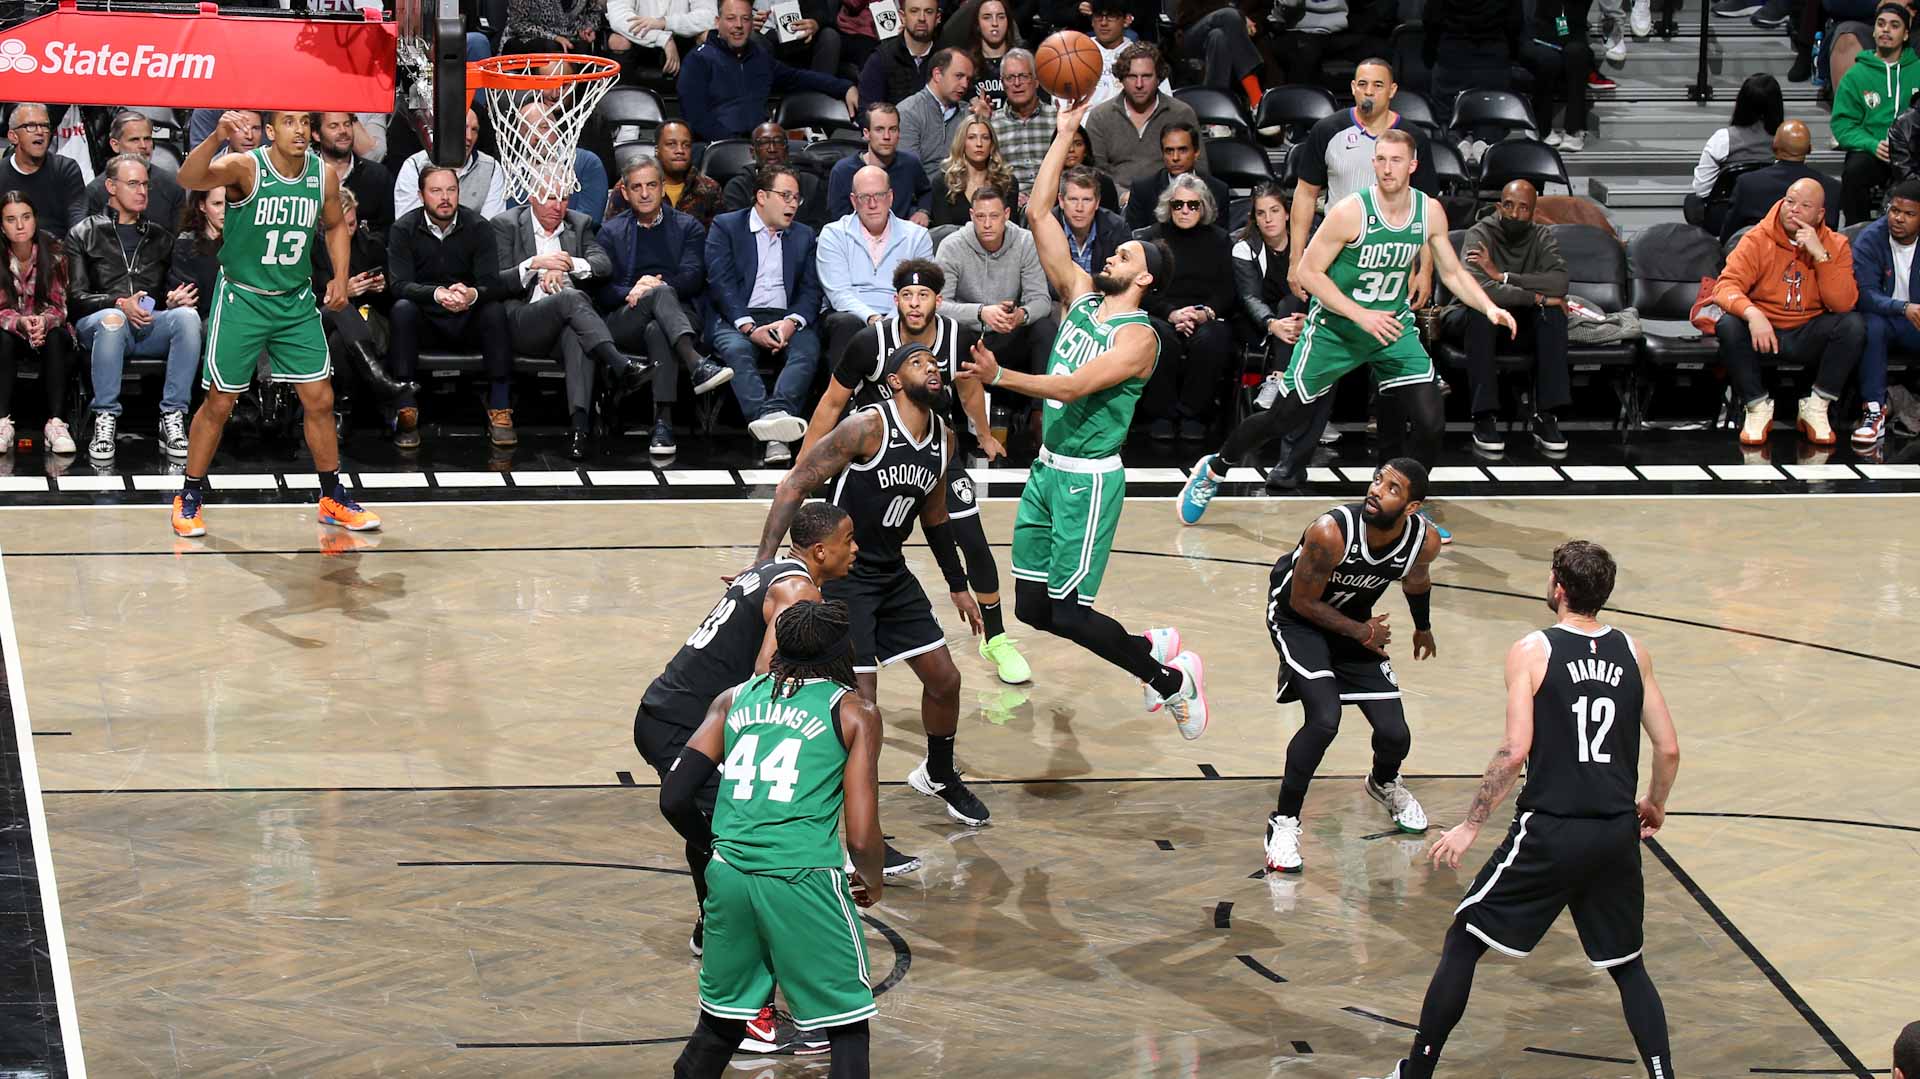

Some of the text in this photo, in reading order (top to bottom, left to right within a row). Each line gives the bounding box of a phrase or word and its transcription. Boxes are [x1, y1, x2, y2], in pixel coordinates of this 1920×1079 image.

[878, 10, 897, 22] NETS
[254, 196, 318, 228] BOSTON
[261, 230, 307, 265] 13
[1357, 243, 1421, 269] BOSTON
[1352, 271, 1406, 303] 30
[891, 428, 899, 438] 6
[877, 464, 938, 496] BROOKLYN
[881, 495, 916, 528] 00
[1328, 571, 1390, 590] ROOKLY
[1328, 591, 1357, 608] 11
[1566, 658, 1624, 687] HARRIS
[727, 702, 828, 741] WILLIAMS III
[1571, 695, 1616, 763] 12
[724, 734, 803, 803] 44
